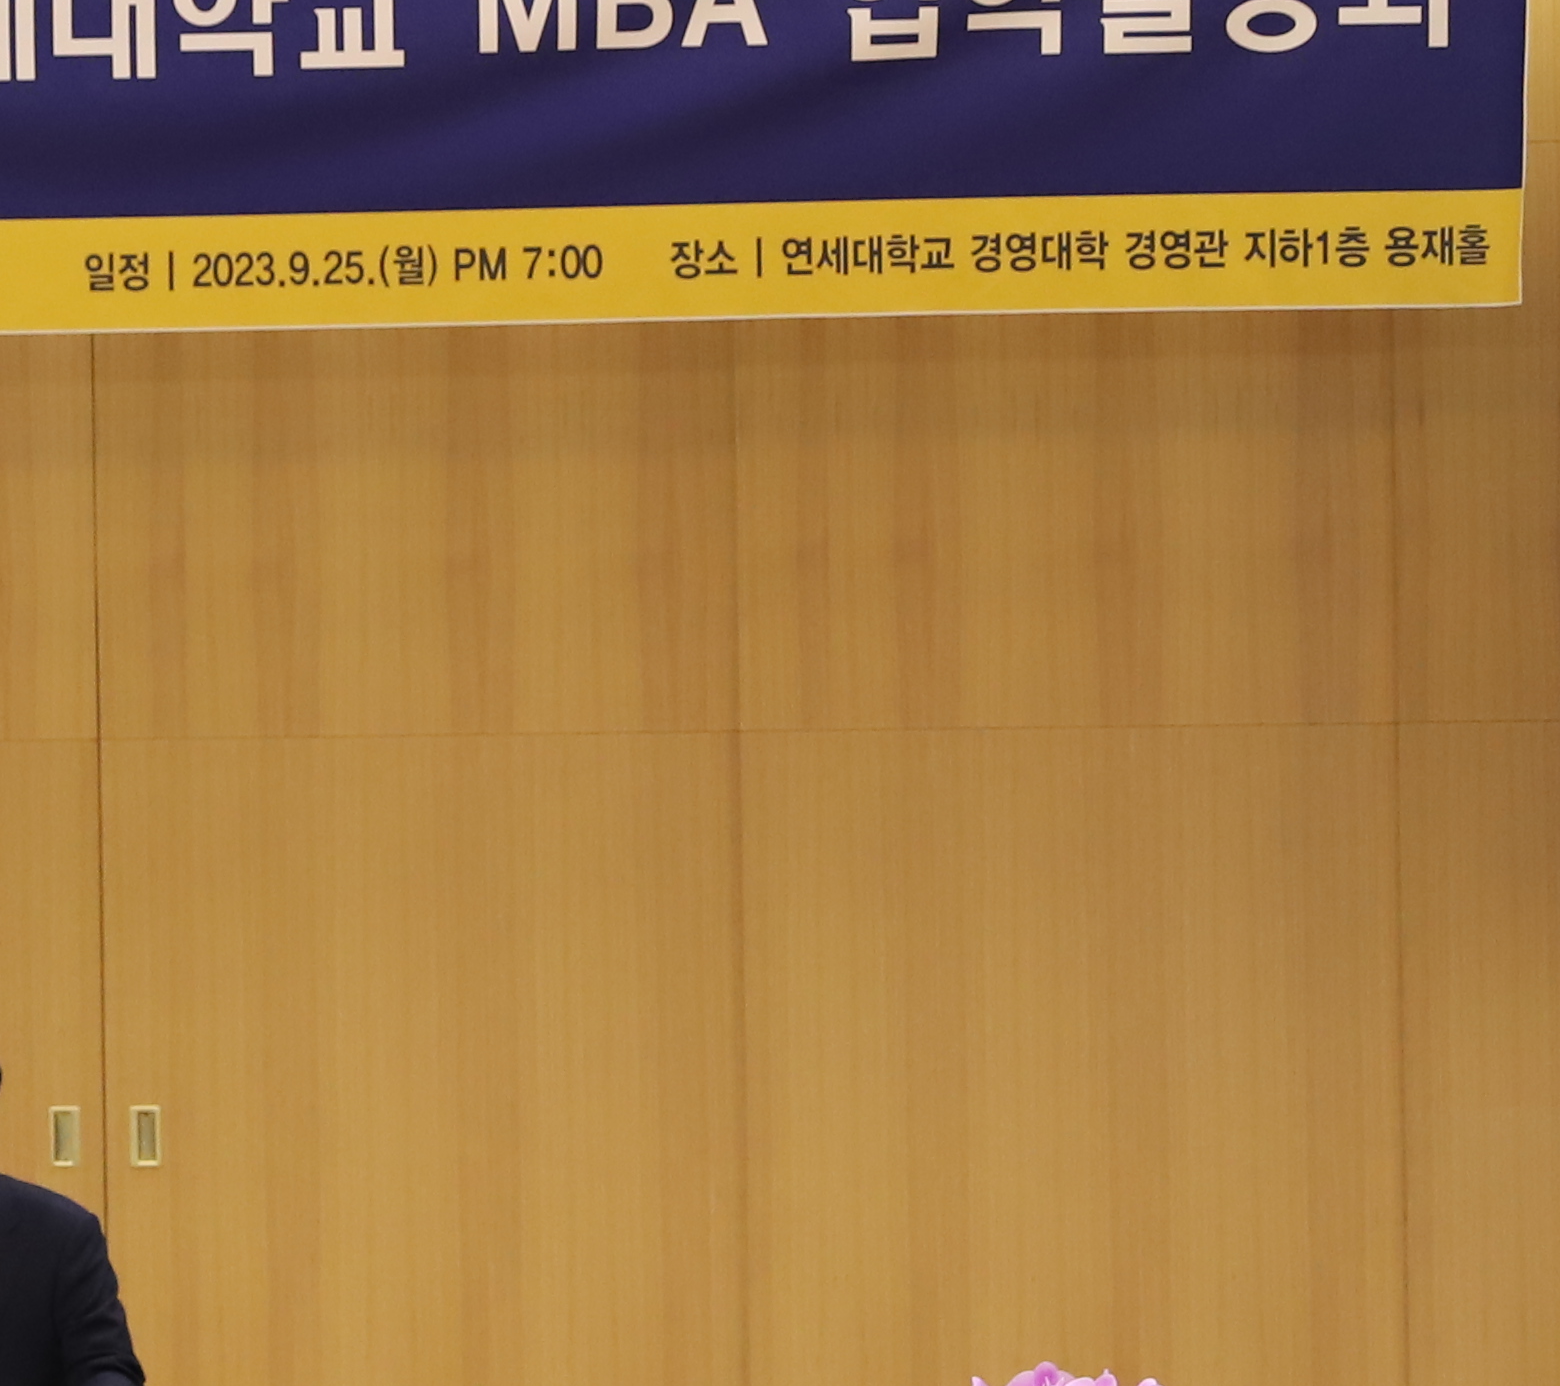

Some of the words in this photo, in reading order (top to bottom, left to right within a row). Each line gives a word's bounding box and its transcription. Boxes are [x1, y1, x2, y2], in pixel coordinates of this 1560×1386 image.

[83, 251, 149, 293] 일정
[192, 244, 438, 289] 2023.9.25.(월)
[453, 245, 508, 283] PM
[521, 243, 604, 281] 7:00
[670, 238, 739, 281] 장소
[781, 233, 956, 277] 연세대학교
[970, 229, 1110, 275] 경영대학
[1125, 227, 1229, 272] 경영관
[1243, 225, 1371, 270] 지하1층
[1384, 223, 1491, 269] 용재홀
